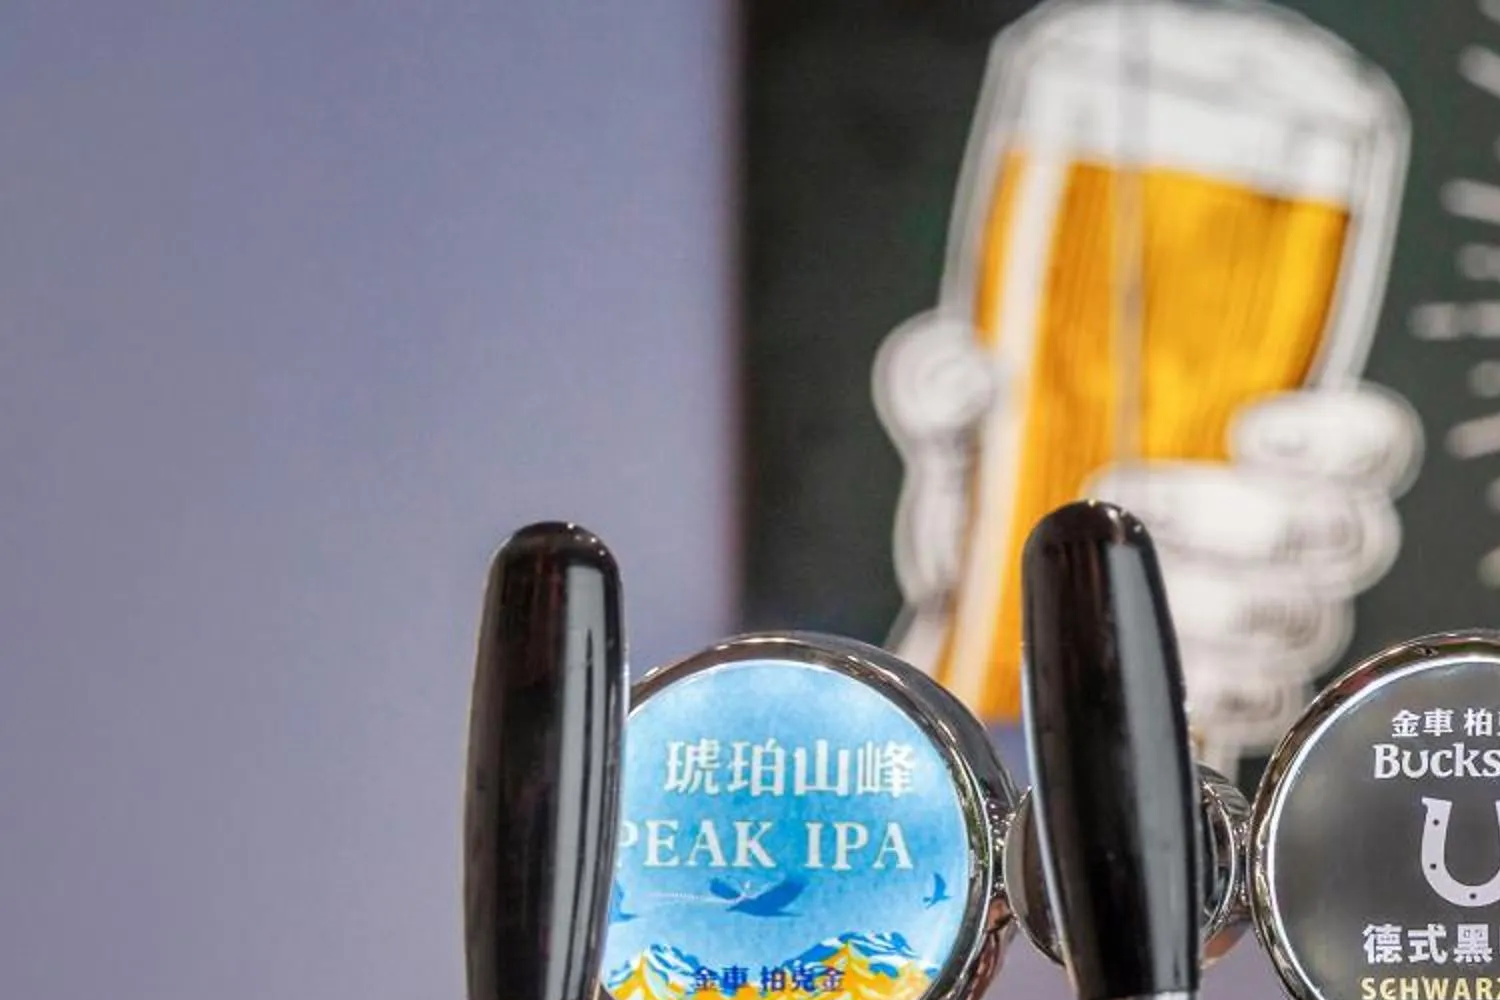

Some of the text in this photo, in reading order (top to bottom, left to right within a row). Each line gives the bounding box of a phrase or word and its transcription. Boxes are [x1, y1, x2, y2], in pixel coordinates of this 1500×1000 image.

[1391, 708, 1454, 737] 金車
[663, 737, 916, 798] 琥珀山峰
[804, 820, 914, 870] IPA
